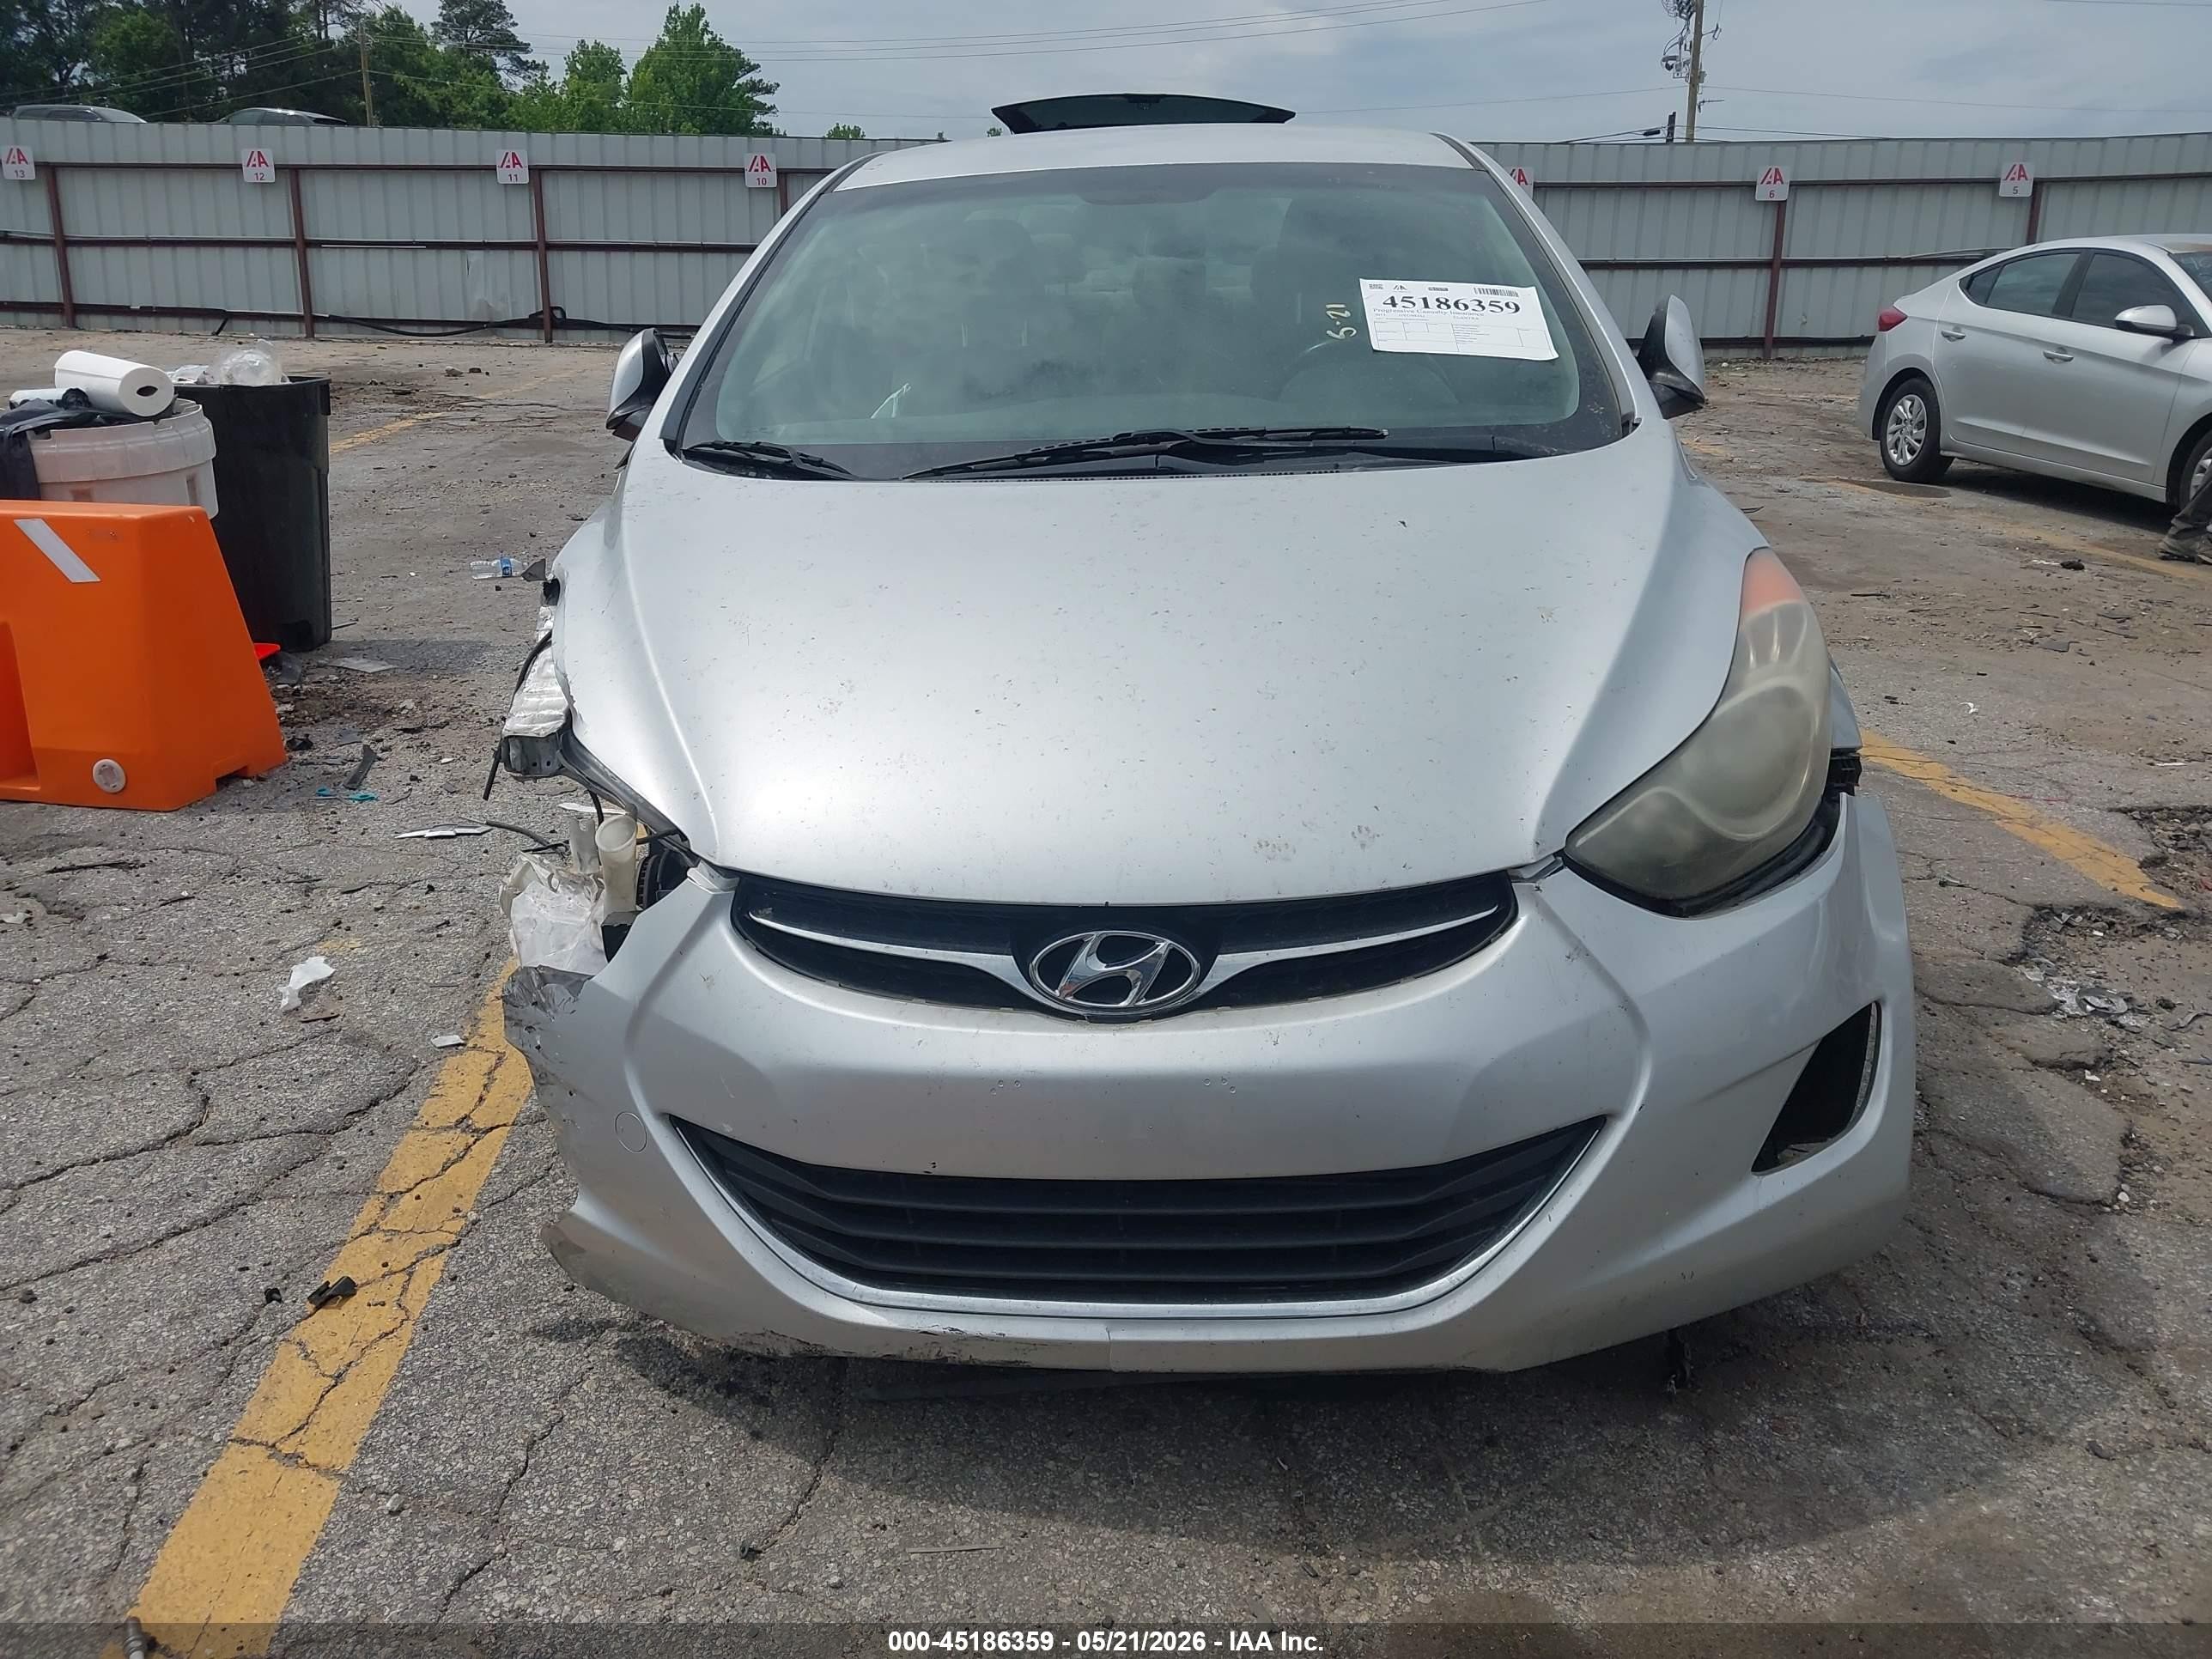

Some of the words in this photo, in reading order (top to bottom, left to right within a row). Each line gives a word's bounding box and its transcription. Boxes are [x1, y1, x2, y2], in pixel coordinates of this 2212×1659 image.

[14, 169, 26, 179] 13
[254, 173, 265, 181] 12
[507, 173, 519, 182] 11
[756, 177, 767, 186] 10
[1768, 191, 1776, 199] 6
[2012, 185, 2019, 196] 5
[1382, 295, 1521, 314] 45186359
